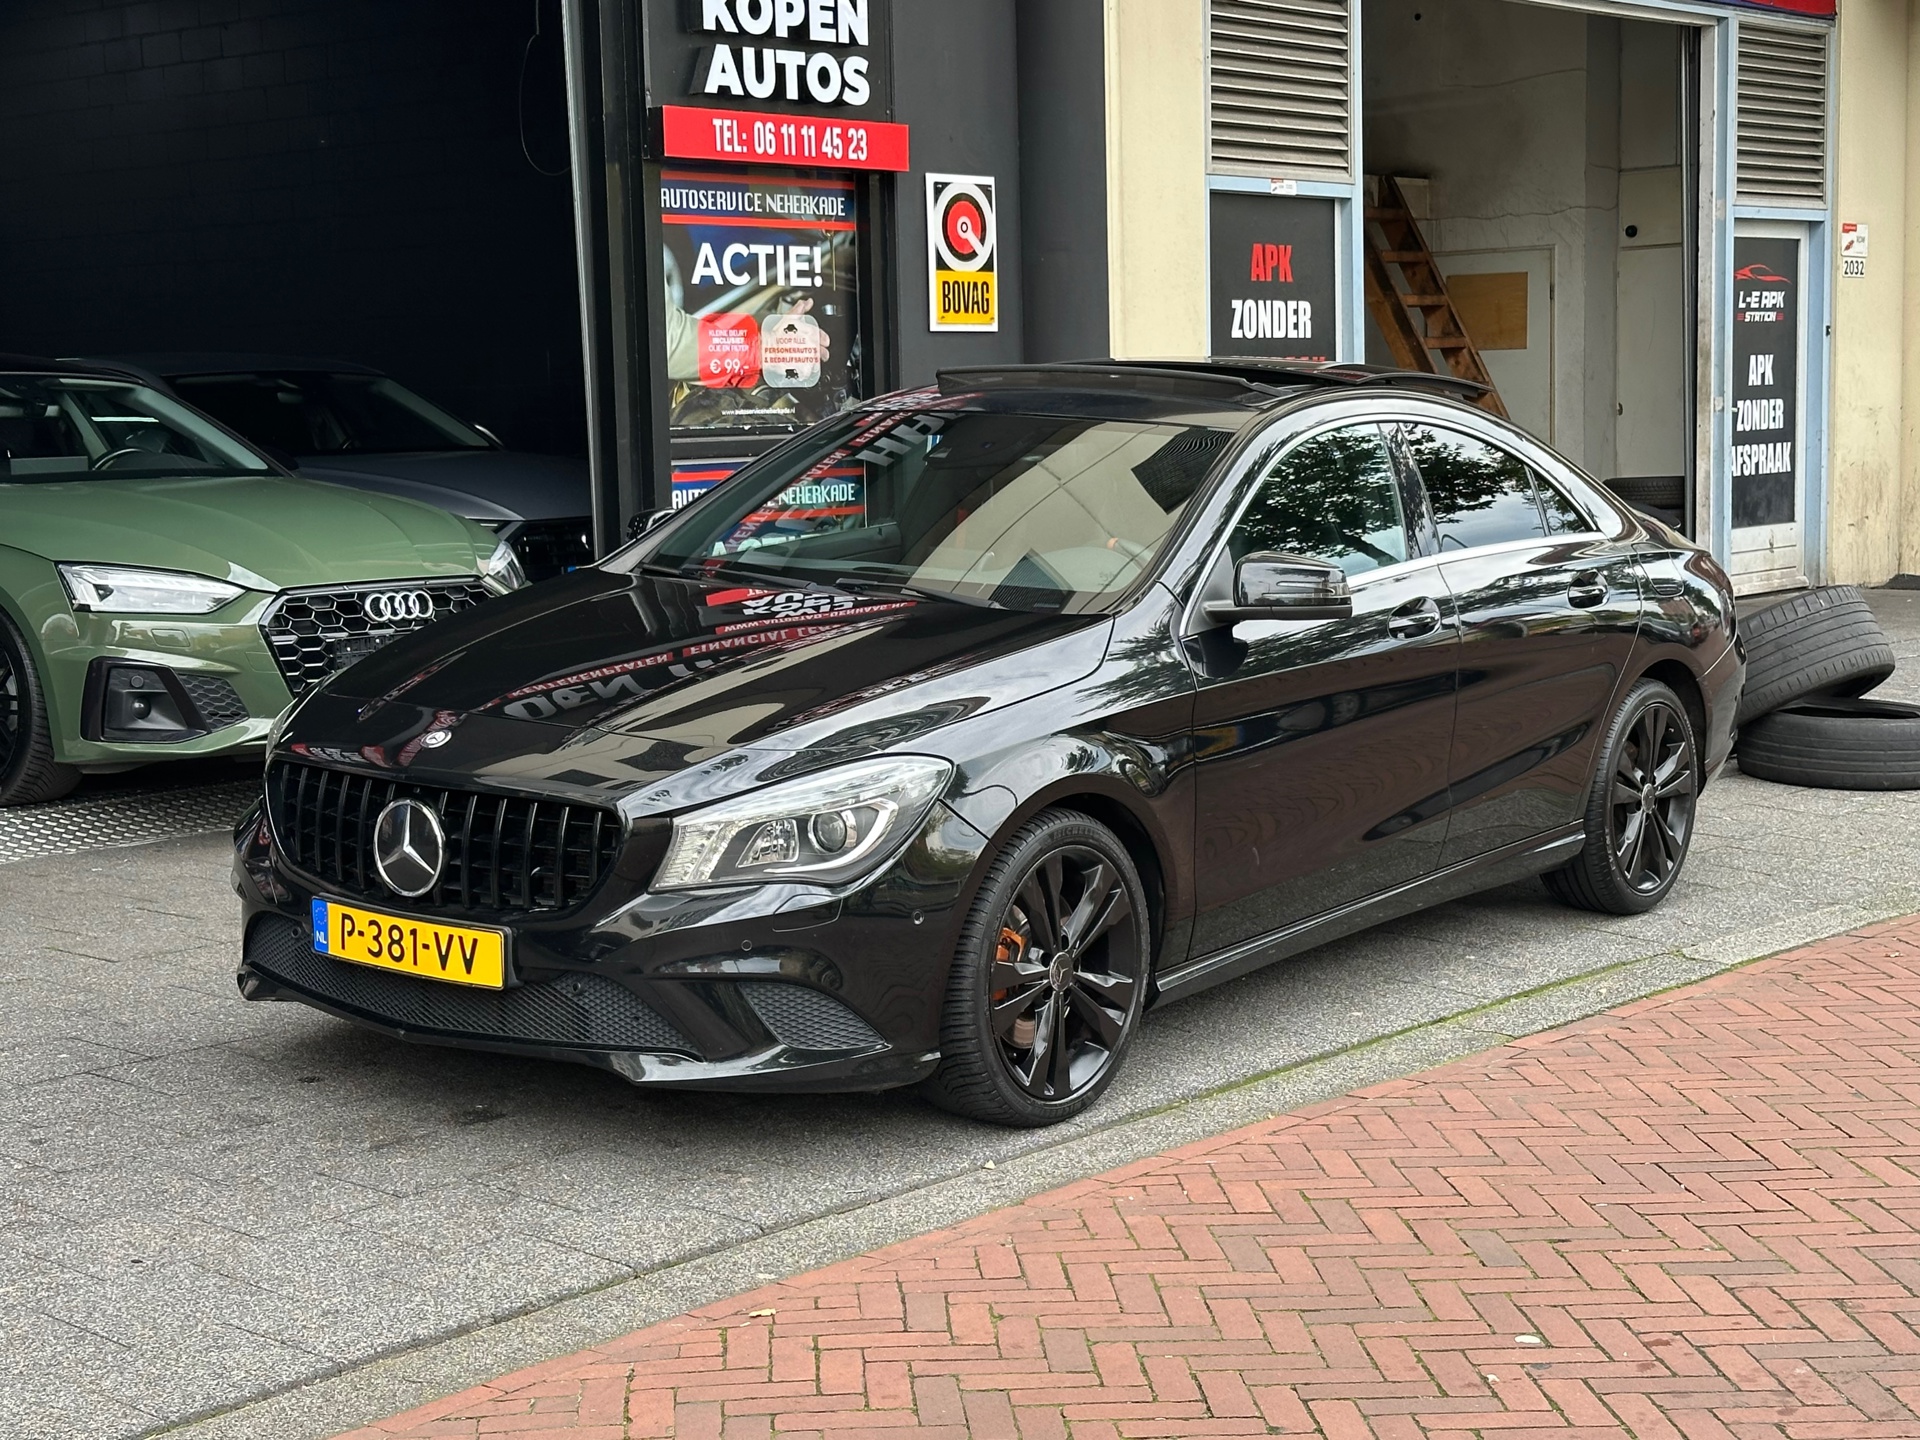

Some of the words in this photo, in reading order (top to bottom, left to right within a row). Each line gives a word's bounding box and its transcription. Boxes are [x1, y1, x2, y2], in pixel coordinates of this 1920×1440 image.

[702, 0, 869, 46] KOPEN
[704, 44, 870, 106] AUTOS
[712, 118, 748, 153] TEL:
[753, 120, 776, 155] 06
[780, 123, 796, 156] 11
[801, 125, 817, 157] 11
[821, 126, 843, 159] 45
[847, 128, 868, 161] 23
[660, 187, 763, 212] AUTOSERVICE
[765, 193, 846, 216] NEHERKADE
[691, 243, 823, 288] ACTIE!
[1251, 243, 1293, 282] APK
[1844, 260, 1864, 275] 2032
[942, 280, 990, 315] BOVAG
[1738, 290, 1761, 309] L-E
[1760, 290, 1786, 309] APK
[1231, 299, 1311, 339] ZONDER
[1744, 311, 1777, 322] STATION
[709, 359, 721, 374] €
[724, 359, 749, 375] 99,-
[1748, 354, 1774, 386] APK
[1736, 398, 1784, 432] ZONDER
[1732, 442, 1791, 477] AFSPRAAK
[778, 483, 856, 504] NEHERKADE
[316, 931, 327, 944] NL
[341, 912, 478, 975] P-381-VV
